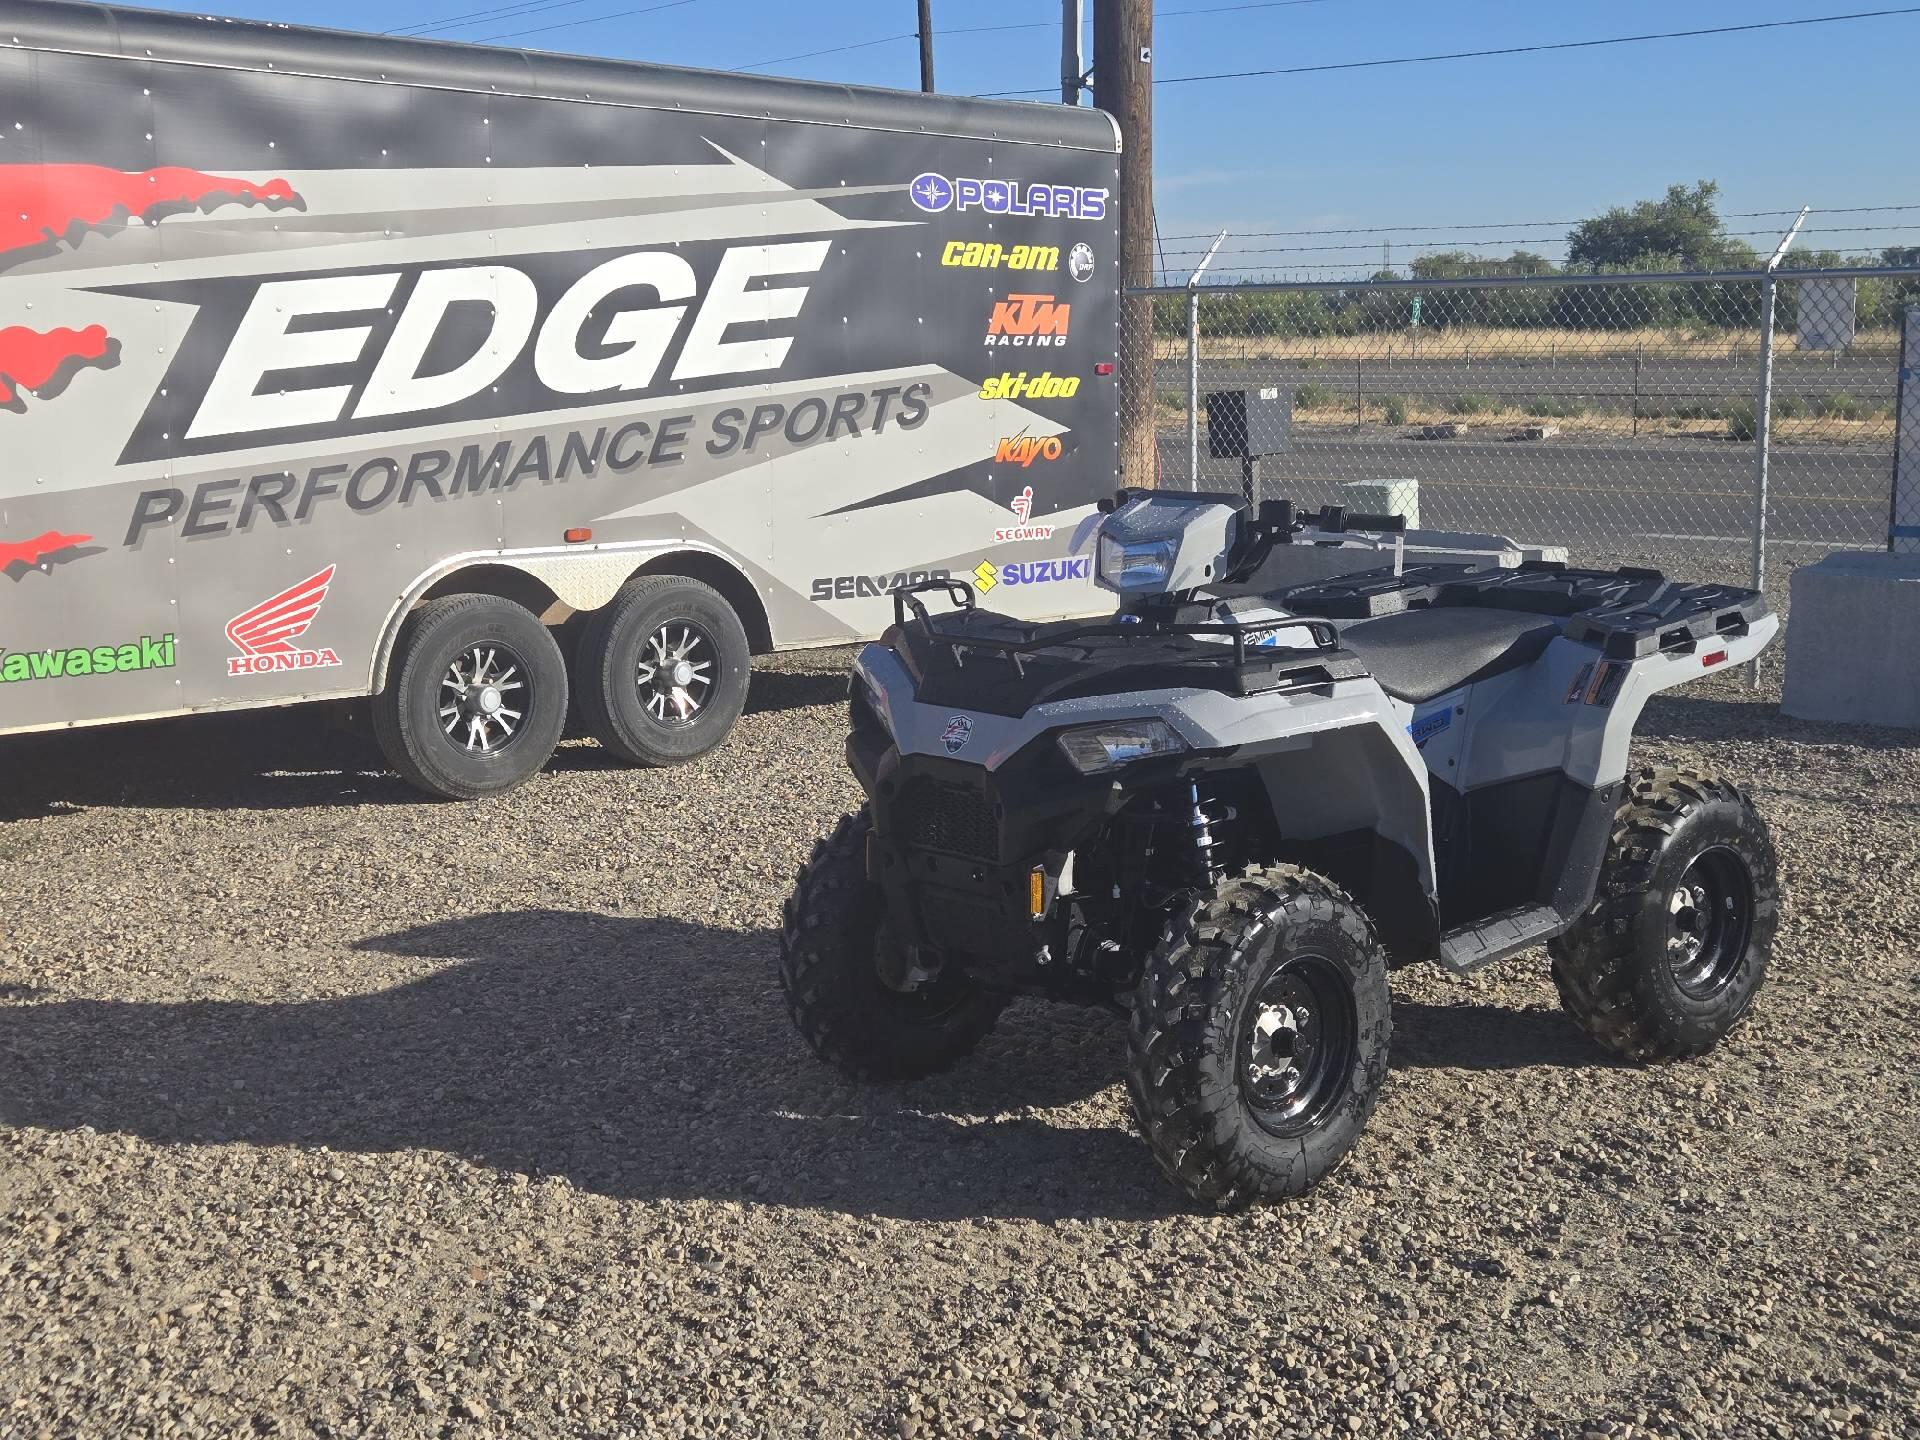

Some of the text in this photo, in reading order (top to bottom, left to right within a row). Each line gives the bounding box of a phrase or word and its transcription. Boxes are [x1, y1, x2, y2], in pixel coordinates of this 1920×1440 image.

[956, 177, 1108, 220] POLARIS
[941, 241, 1059, 270] can-am
[988, 294, 1070, 335] KTM
[185, 240, 832, 438] EDGE
[984, 335, 1066, 346] RACING
[979, 371, 1080, 400] ski-doo
[995, 424, 1061, 468] KAYO
[125, 383, 931, 547] PERFORMANCE SPORTS
[995, 527, 1054, 541] SEGWAY
[1002, 558, 1089, 585] SUZUKI
[0, 633, 175, 683] awasaki
[228, 649, 342, 676] HONDA
